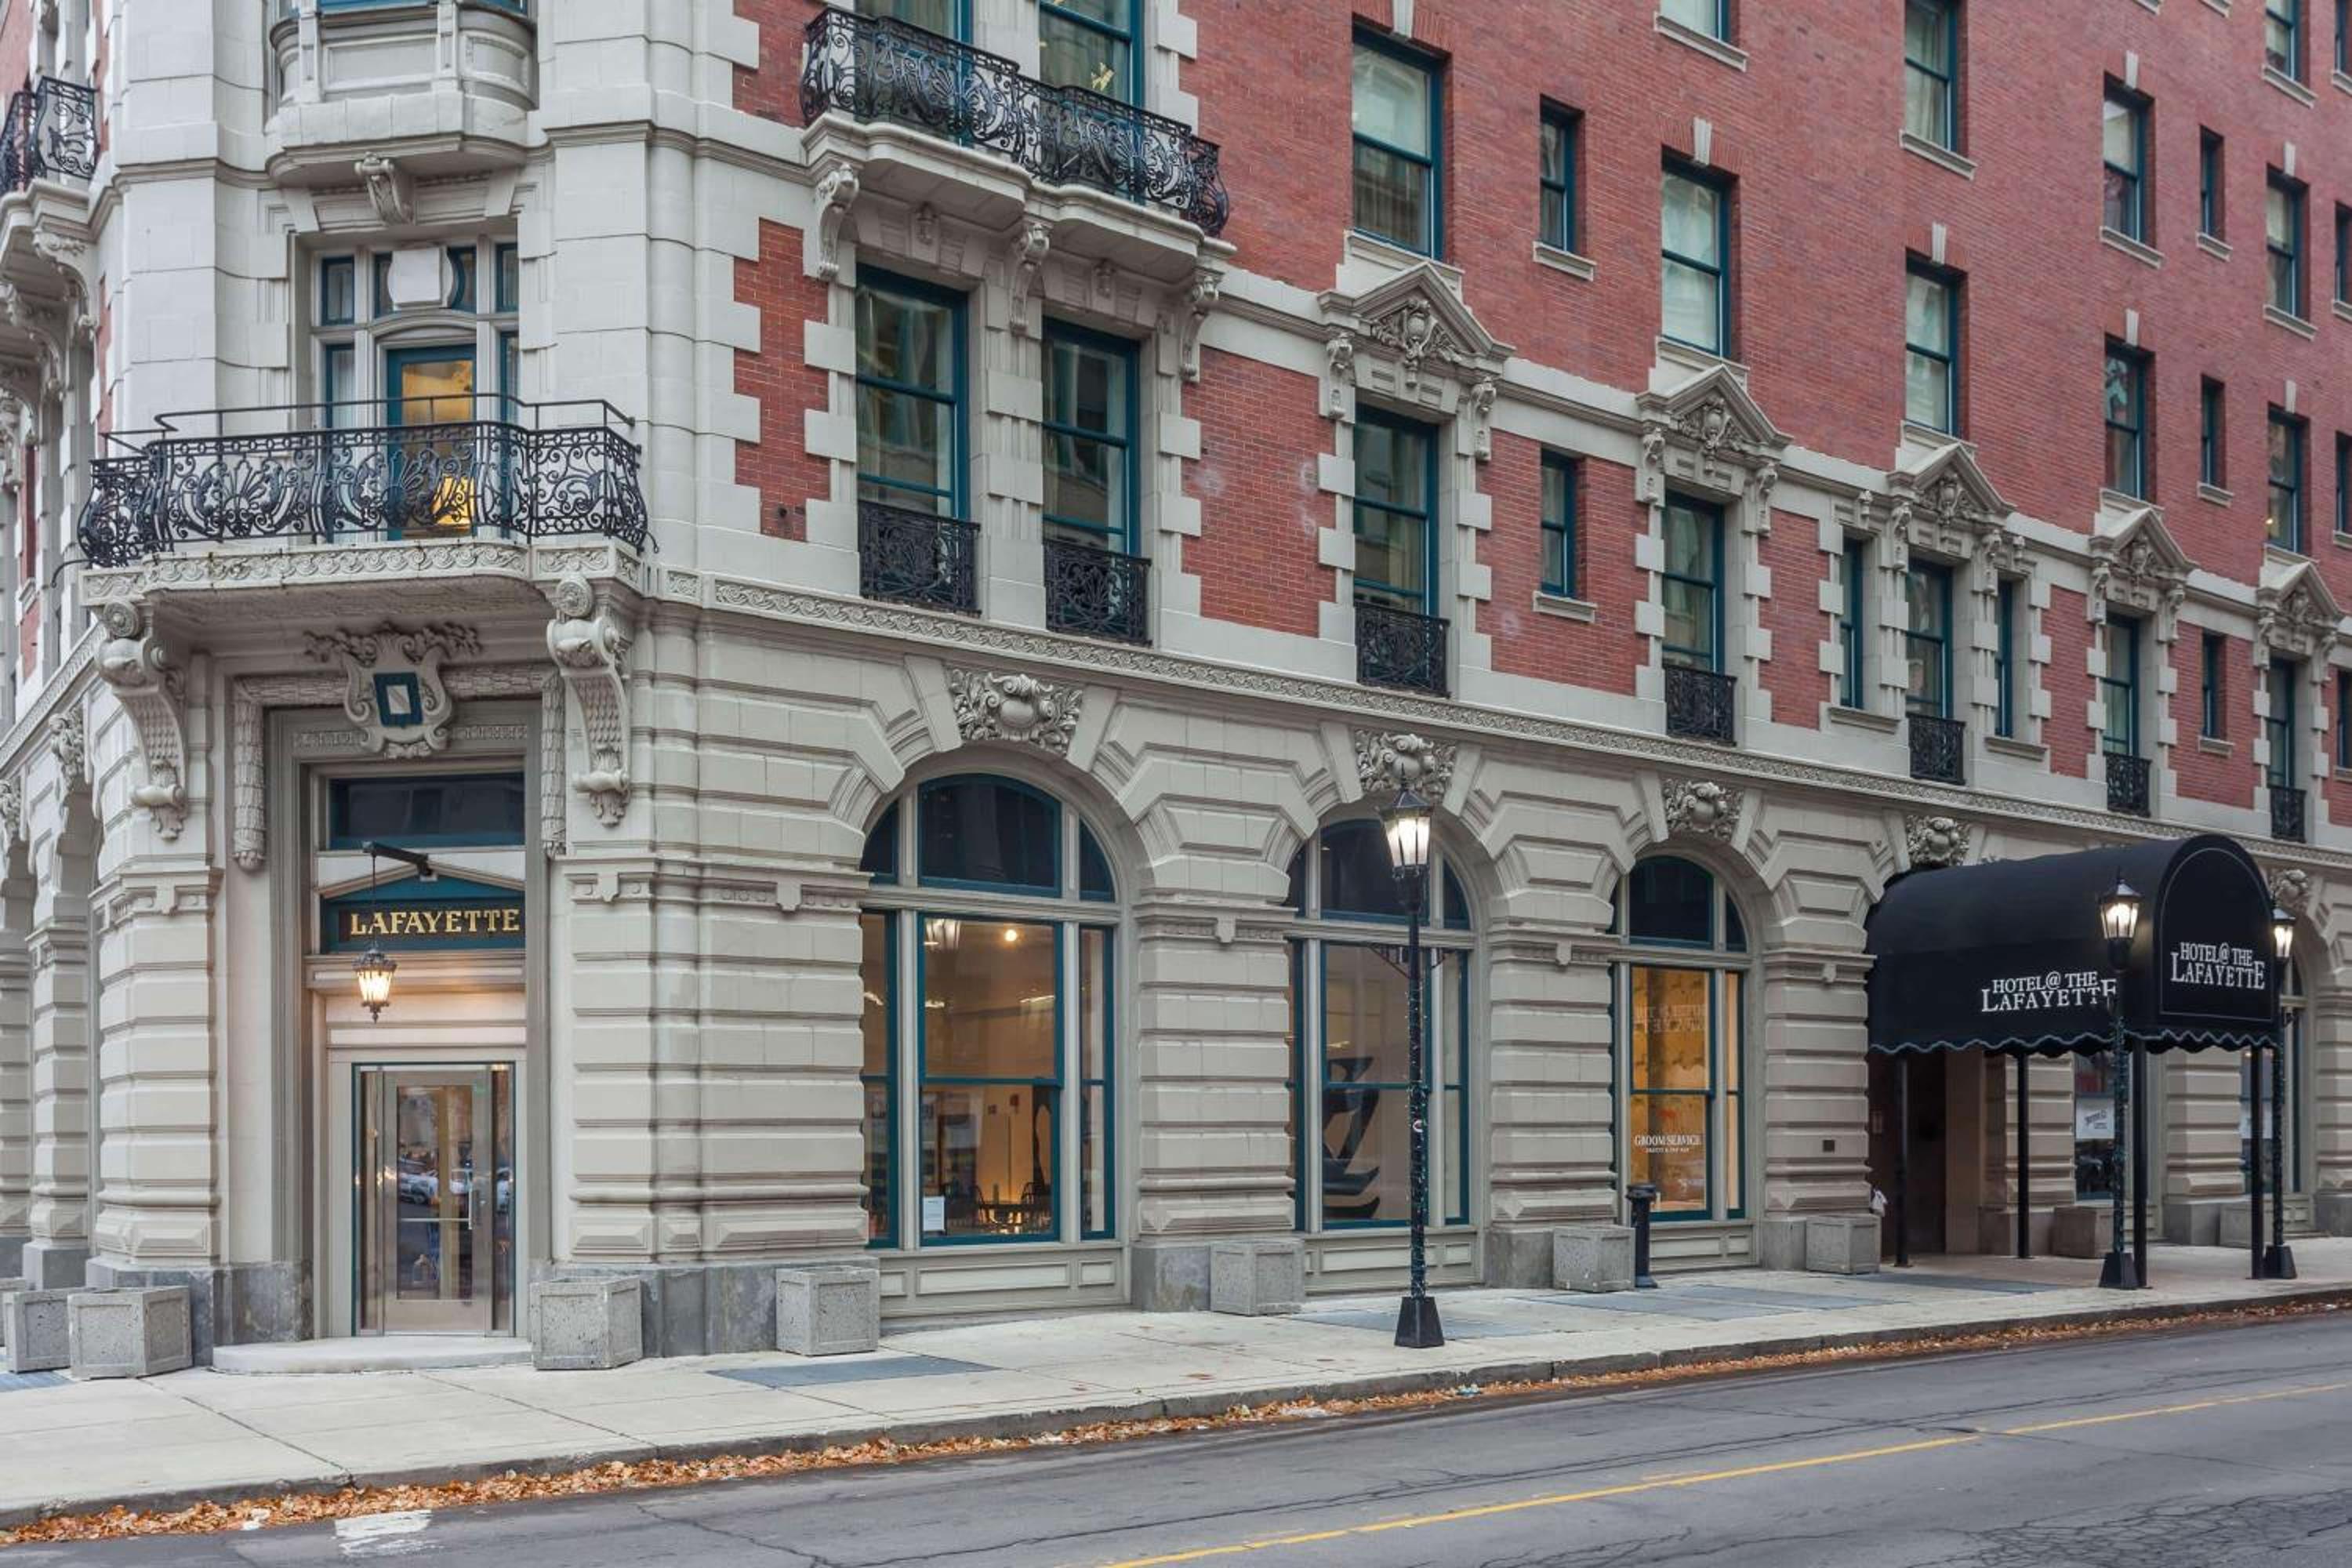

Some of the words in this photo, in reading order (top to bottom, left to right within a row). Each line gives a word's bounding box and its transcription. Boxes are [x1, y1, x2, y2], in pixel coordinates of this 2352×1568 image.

[350, 909, 520, 935] LAFAYETTE
[2230, 947, 2253, 967] THE
[2065, 971, 2099, 989] THE
[2169, 951, 2265, 990] LAFAYETTE
